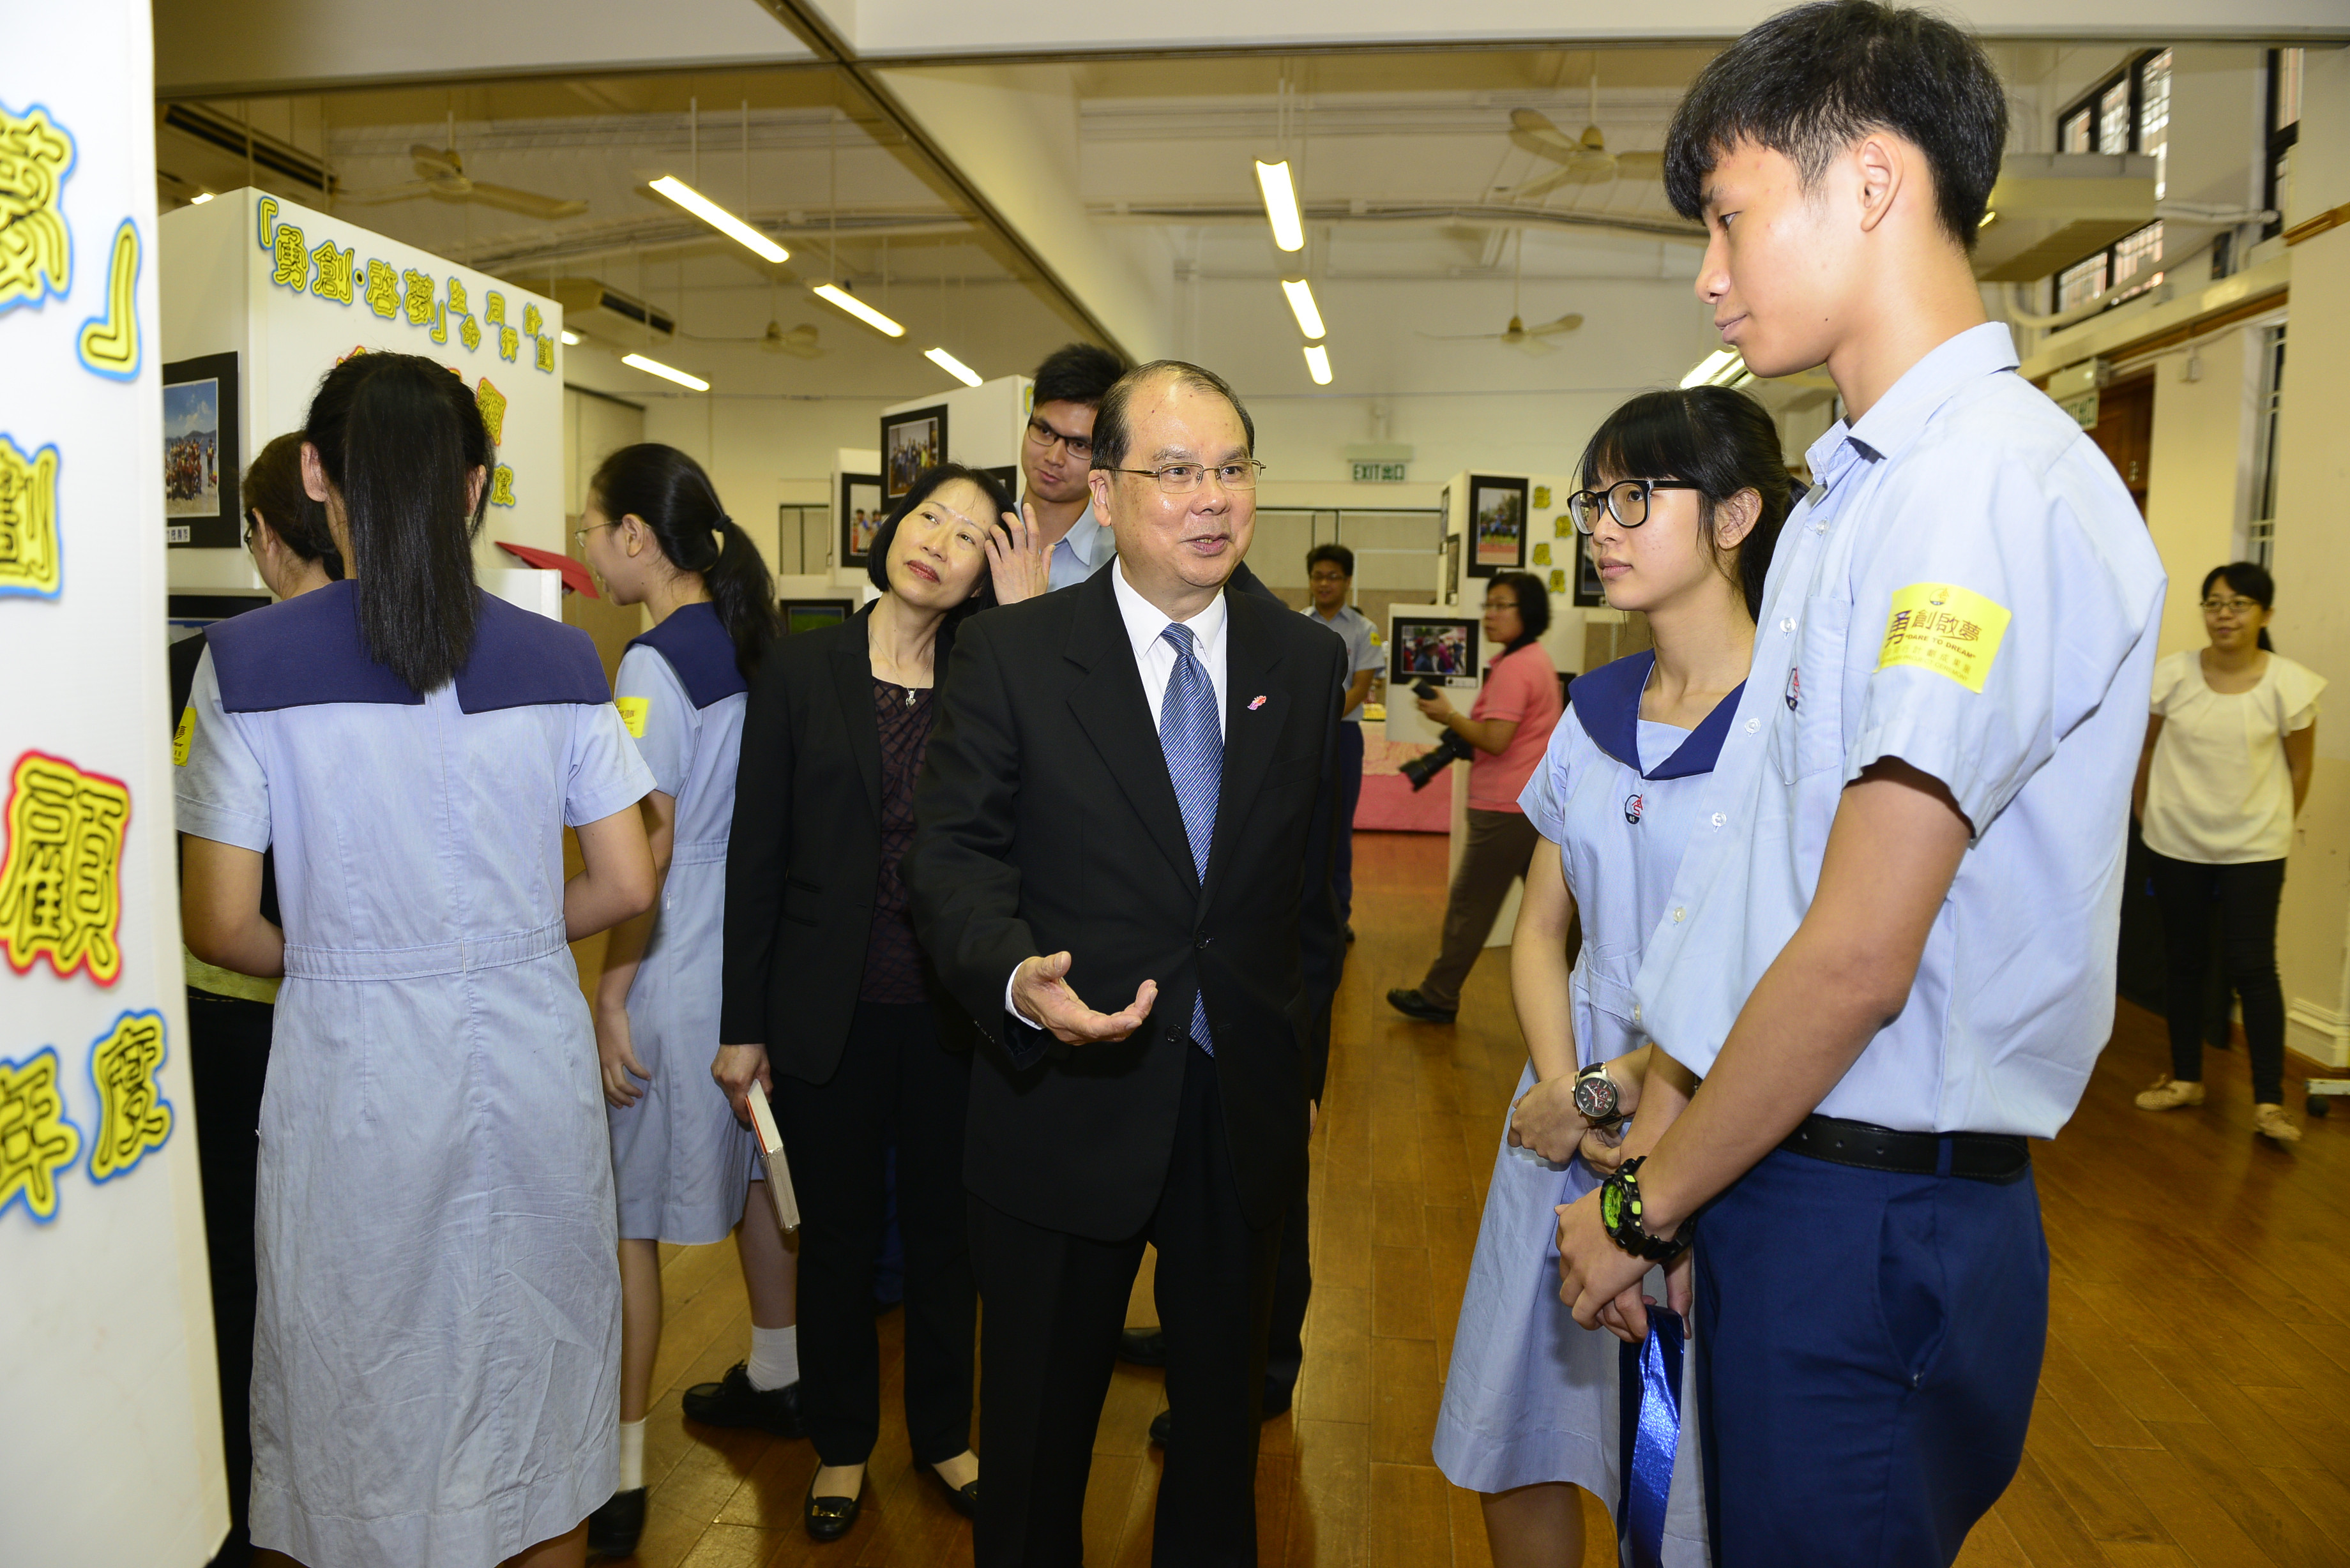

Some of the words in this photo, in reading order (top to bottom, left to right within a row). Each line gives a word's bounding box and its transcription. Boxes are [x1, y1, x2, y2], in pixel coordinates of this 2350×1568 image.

[1353, 464, 1380, 480] EXIT
[1382, 464, 1406, 480] 出口
[1932, 637, 1943, 646] TO
[1935, 661, 1969, 681] CEREMONY
